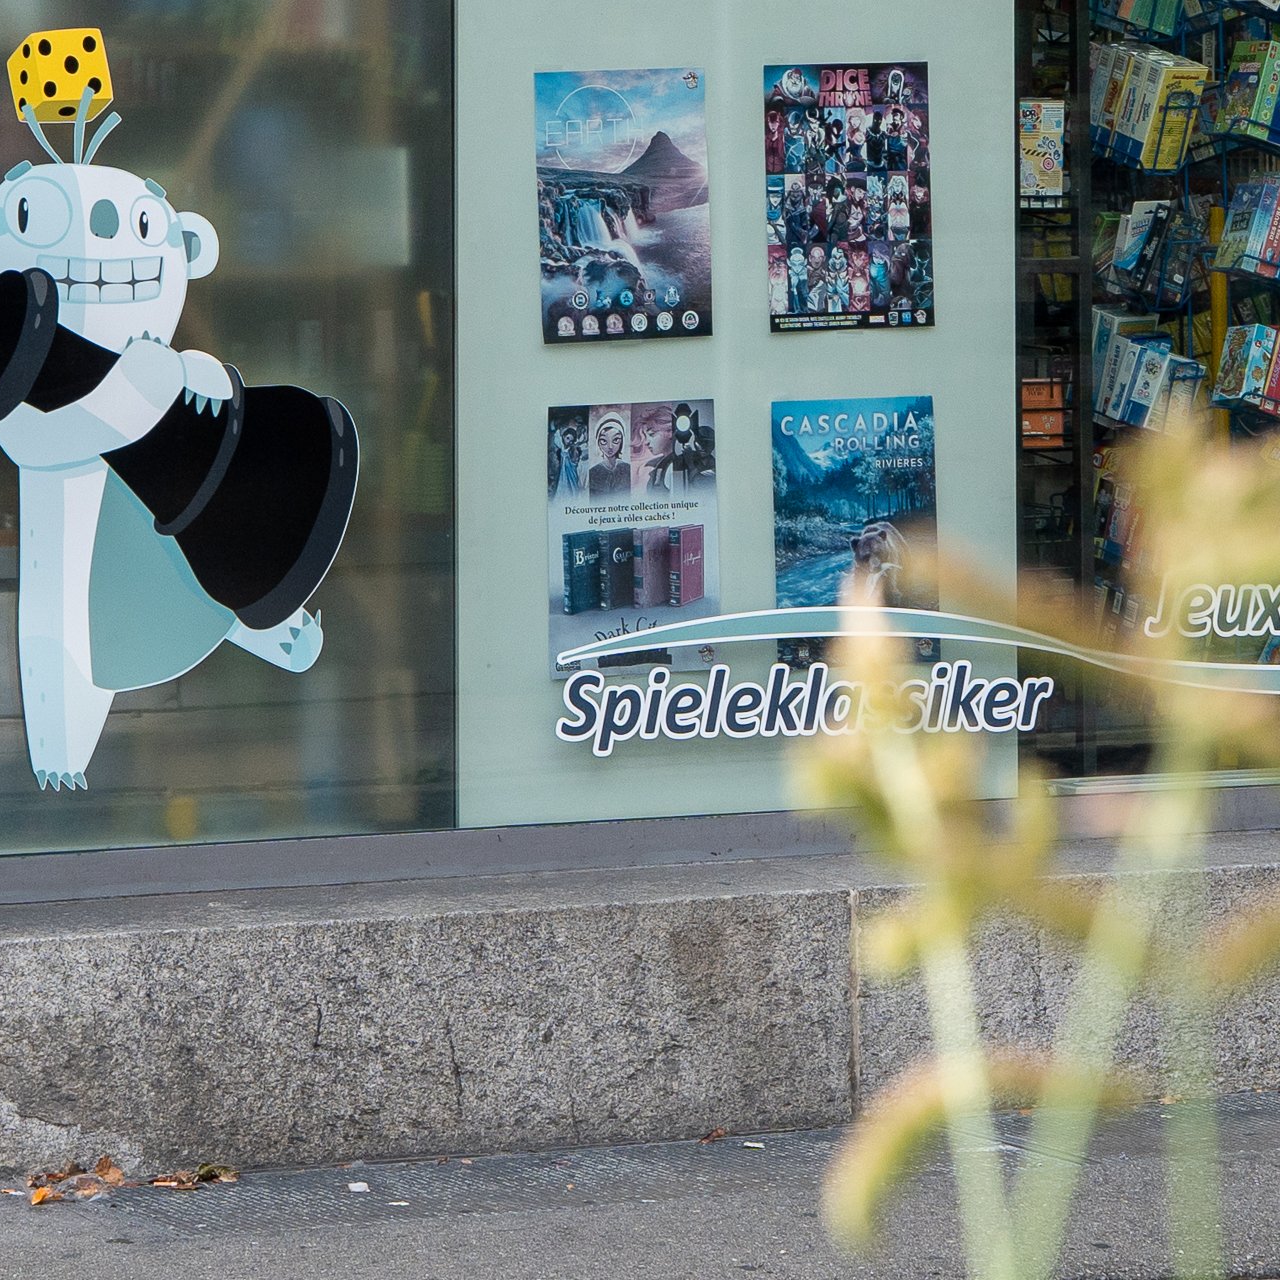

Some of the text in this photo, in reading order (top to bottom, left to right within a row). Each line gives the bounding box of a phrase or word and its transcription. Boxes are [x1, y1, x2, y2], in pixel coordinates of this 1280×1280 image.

[821, 68, 871, 93] DICE
[545, 118, 645, 146] EARTH
[780, 411, 919, 436] CASCADIA
[834, 434, 920, 452] ROLLING
[565, 500, 699, 515] Découvrez notre collection unique
[588, 516, 599, 525] de
[599, 516, 616, 526] jeux
[617, 515, 622, 523] à
[624, 513, 643, 523] rôles
[644, 511, 671, 522] cachés
[593, 616, 631, 642] Dark
